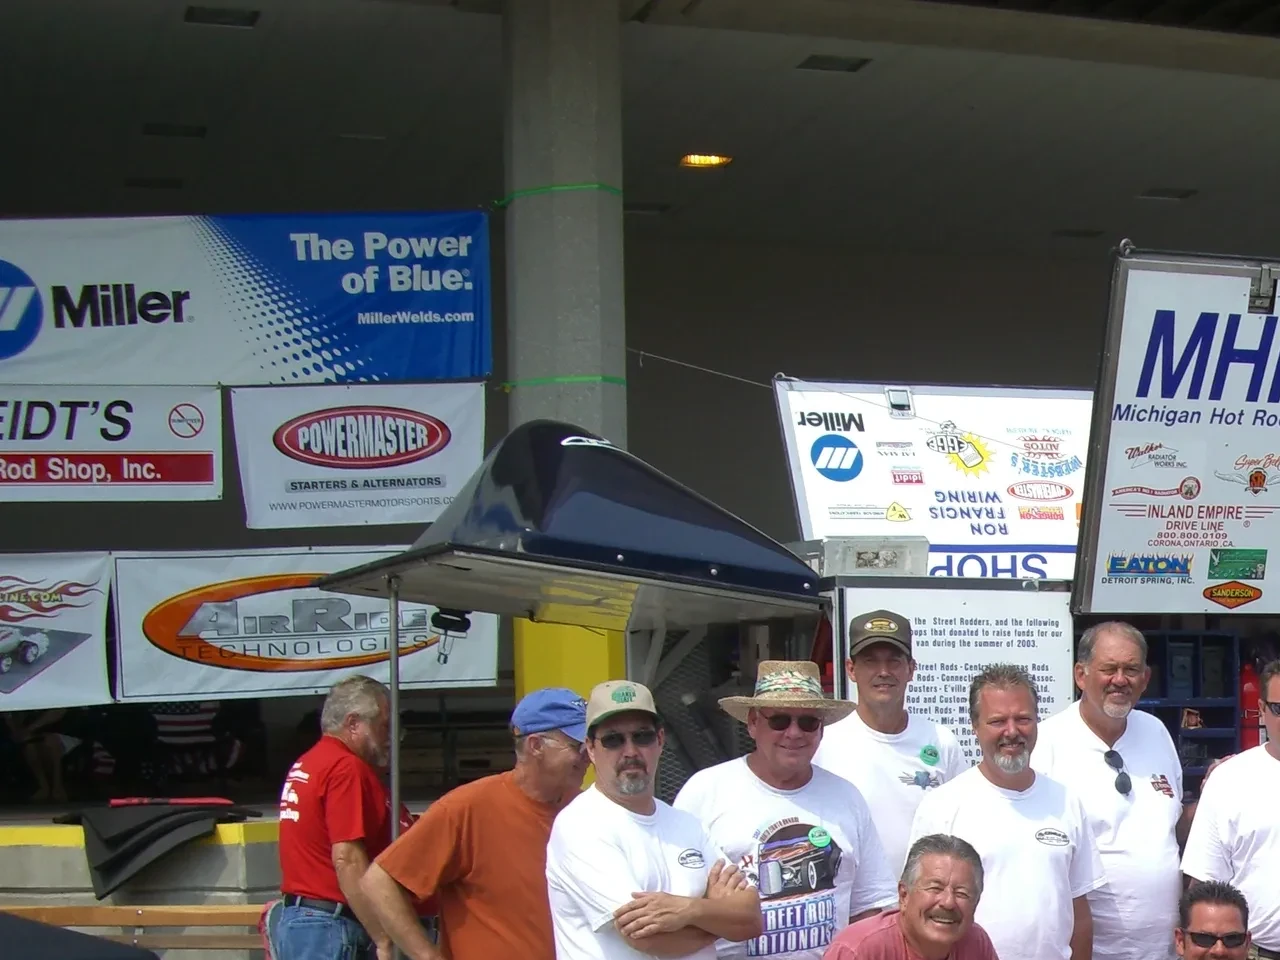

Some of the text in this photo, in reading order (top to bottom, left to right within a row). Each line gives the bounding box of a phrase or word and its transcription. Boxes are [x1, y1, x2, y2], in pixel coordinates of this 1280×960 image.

[289, 231, 473, 261] The Power
[341, 264, 474, 294] of Blue.
[51, 283, 191, 329] Miller
[357, 310, 475, 325] MillerWelds.com
[1112, 403, 1202, 425] Michigan
[1209, 407, 1244, 425] Hot
[798, 411, 865, 433] Miller
[297, 414, 429, 458] POWERMASTER
[926, 434, 967, 453] EGGE
[1024, 442, 1060, 451] AUTOS
[48, 456, 112, 483] Shop,
[122, 458, 162, 479] Inc.
[1234, 454, 1263, 471] Super
[290, 477, 442, 491] STARTERS & ALTERNATORS
[934, 490, 1003, 504] WIRING
[929, 506, 1006, 520] FRANCIS
[1147, 505, 1243, 520] INLAND EMPIRE
[971, 523, 1009, 536] RON
[1166, 521, 1224, 532] DRIVE LINE
[1156, 531, 1228, 540] 800.800.0109
[1110, 557, 1189, 573] EATON
[1140, 577, 1175, 586] SPRING,
[1211, 588, 1254, 598] SANDERSON
[932, 617, 957, 626] Street
[960, 617, 992, 627] Rodders,
[995, 618, 1008, 626] and
[1011, 618, 1023, 626] the
[1026, 618, 1060, 628] following
[949, 629, 979, 637] donated
[982, 629, 990, 637] to
[1014, 629, 1034, 637] funds
[932, 639, 956, 648] during
[1005, 640, 1014, 648] of
[1016, 640, 1038, 648] 2003.
[914, 663, 938, 671] Street
[940, 663, 958, 671] Rods
[1031, 663, 1049, 671] Rods
[917, 674, 935, 682] Rods
[908, 685, 938, 693] Dusters
[906, 695, 919, 703] Rod
[908, 706, 952, 714] Street Rods
[763, 899, 834, 931] REET ROD
[747, 923, 835, 956] NATIONALS
